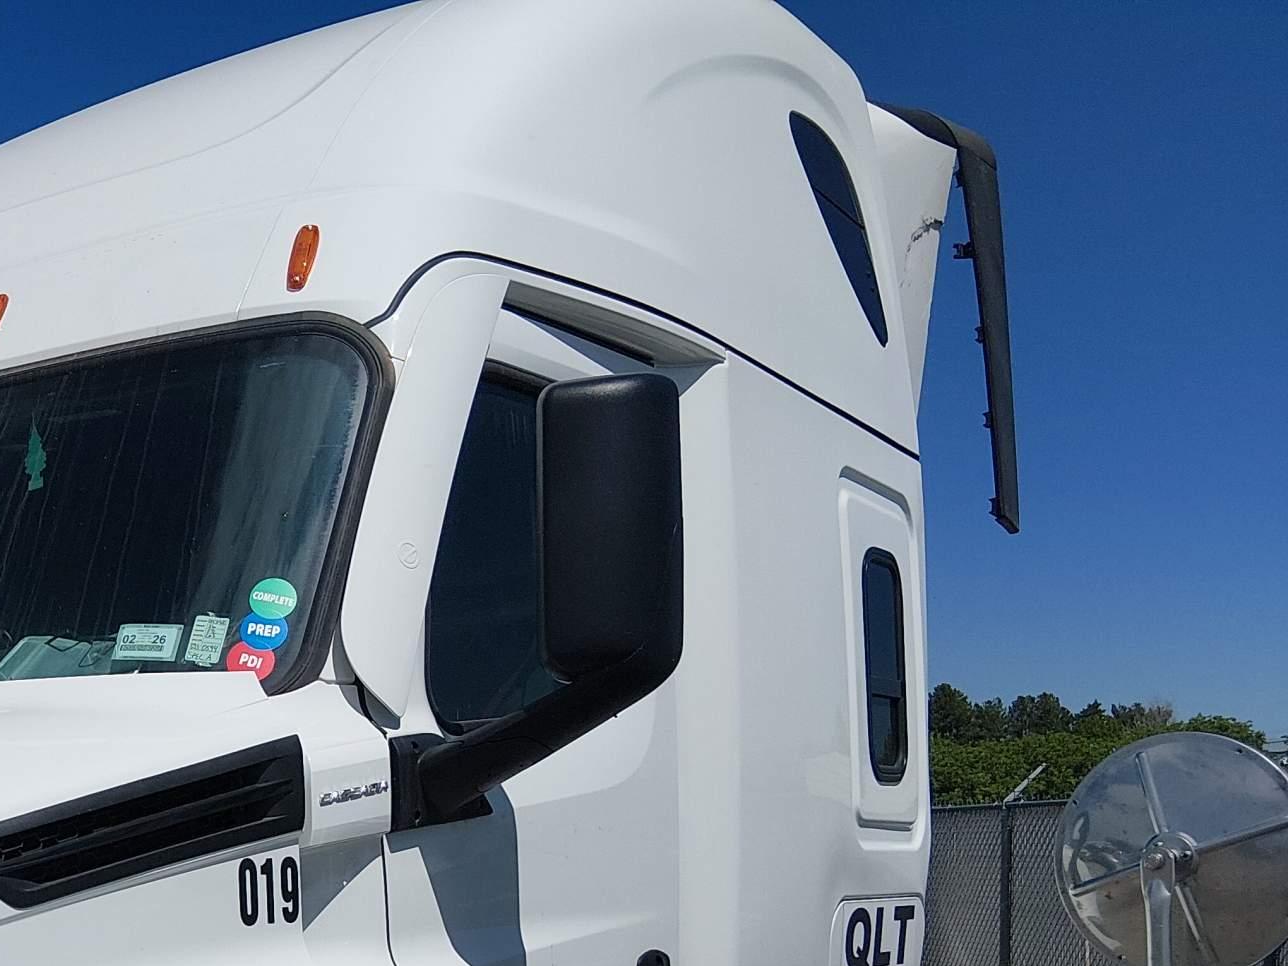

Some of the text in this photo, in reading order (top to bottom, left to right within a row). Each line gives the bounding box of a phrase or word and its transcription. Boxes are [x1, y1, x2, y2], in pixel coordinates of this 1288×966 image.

[253, 591, 294, 607] COMPLETE
[247, 622, 281, 638] PREP
[122, 634, 167, 644] 02 26
[238, 652, 263, 669] PDI
[238, 856, 300, 927] 019
